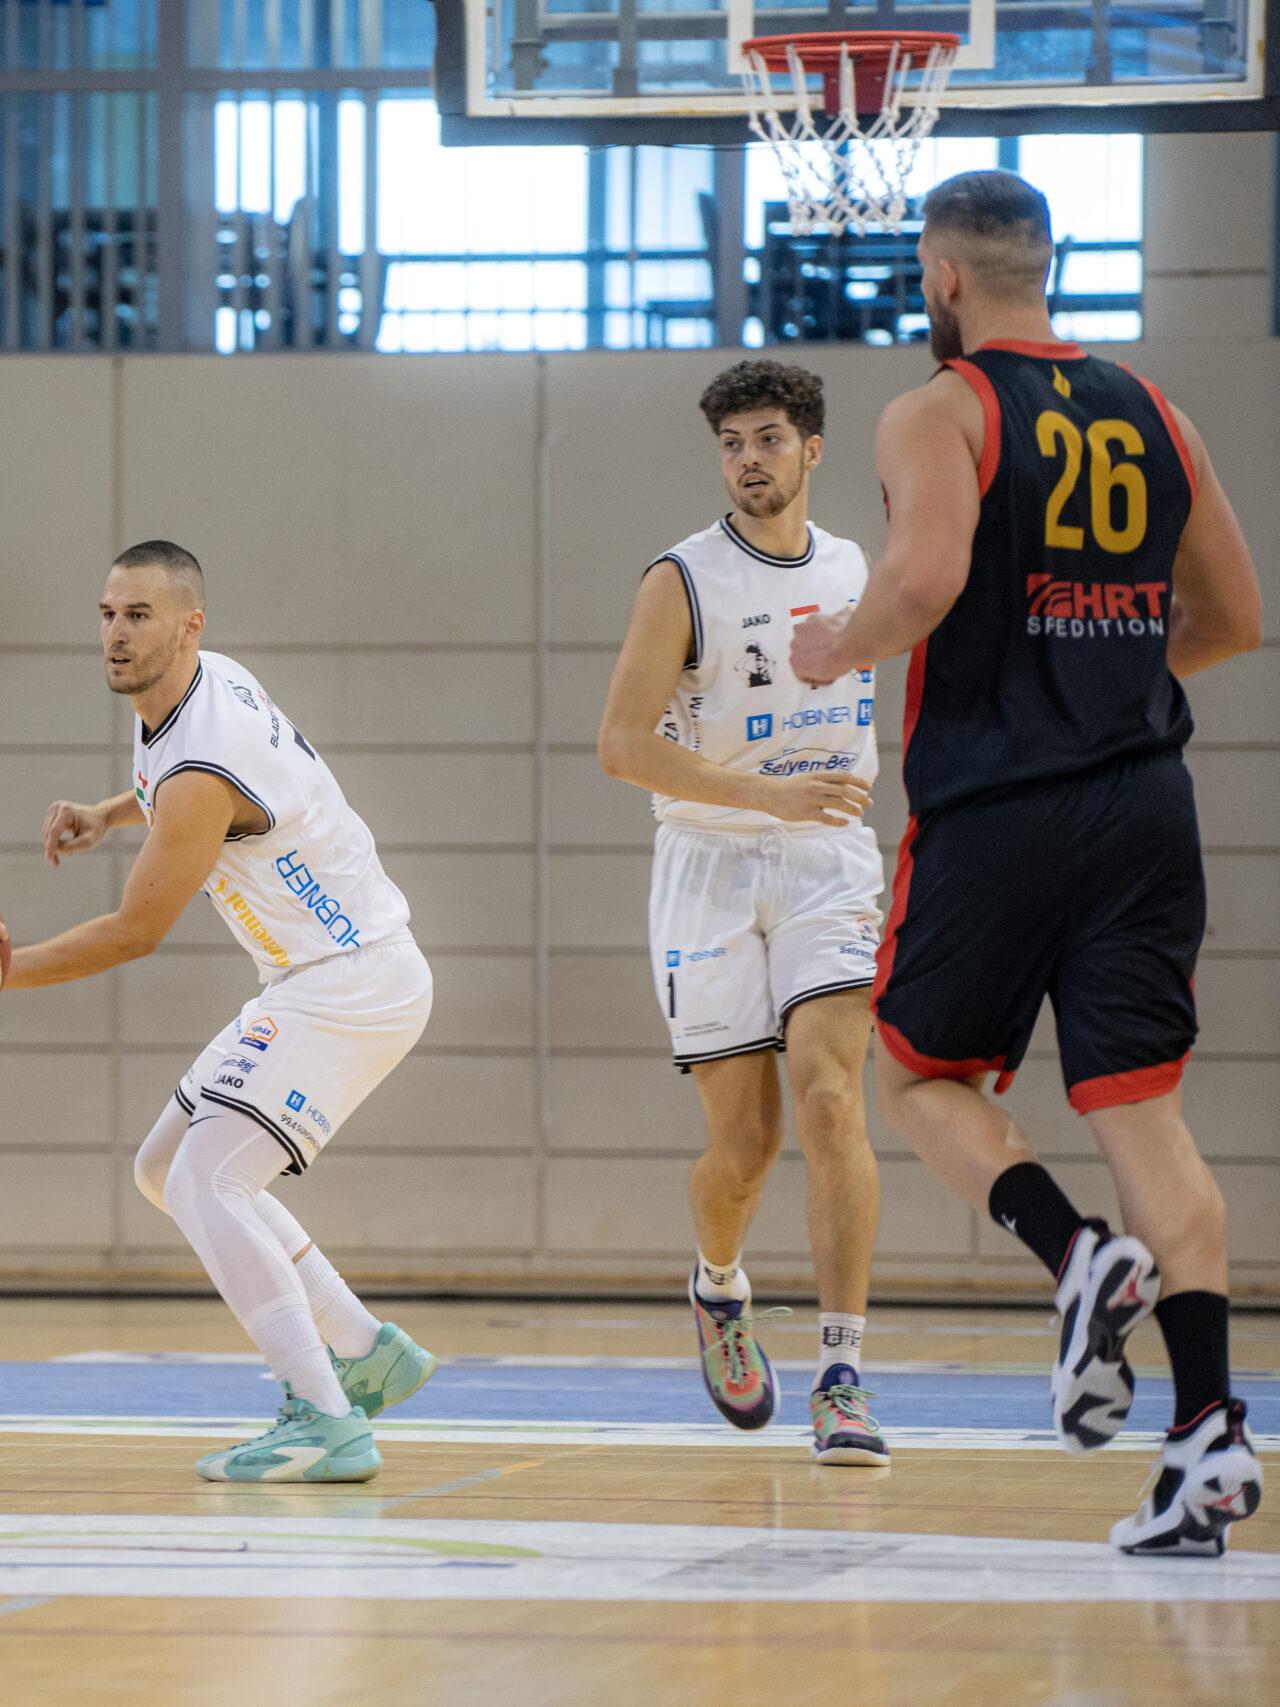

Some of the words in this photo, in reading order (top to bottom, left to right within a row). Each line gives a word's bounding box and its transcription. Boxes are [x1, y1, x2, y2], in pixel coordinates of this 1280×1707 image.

[1036, 410, 1147, 553] 26
[1027, 616, 1165, 638] SPEDITION
[1073, 582, 1168, 619] HRT
[276, 850, 360, 948] HÜBNER
